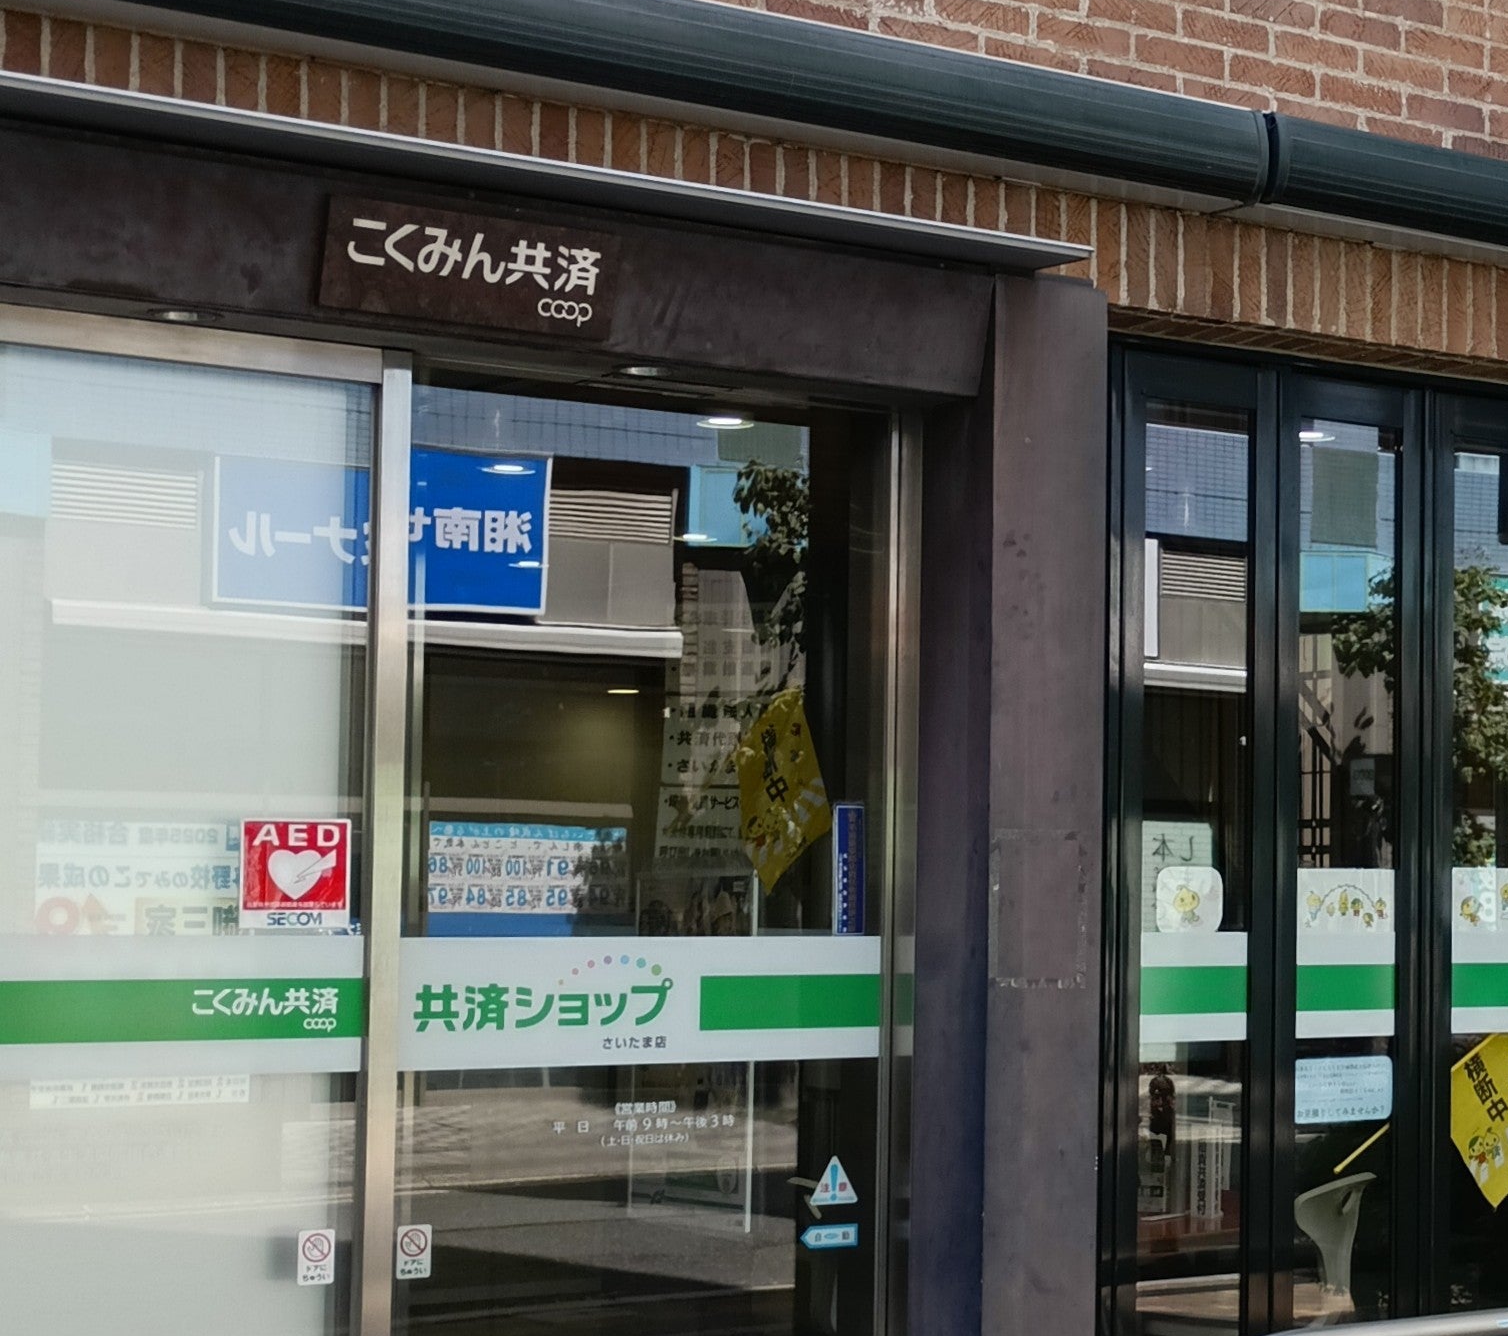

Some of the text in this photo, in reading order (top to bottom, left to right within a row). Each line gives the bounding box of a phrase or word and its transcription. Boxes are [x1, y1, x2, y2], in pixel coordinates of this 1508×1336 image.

[347, 217, 602, 296] こくみん共済
[252, 823, 341, 848] AED
[266, 911, 322, 926] SECOM
[191, 987, 340, 1016] こくみん共済
[412, 977, 674, 1033] 共済ショップ
[602, 1036, 667, 1051] さいたま店
[1464, 1052, 1508, 1122] 横断中
